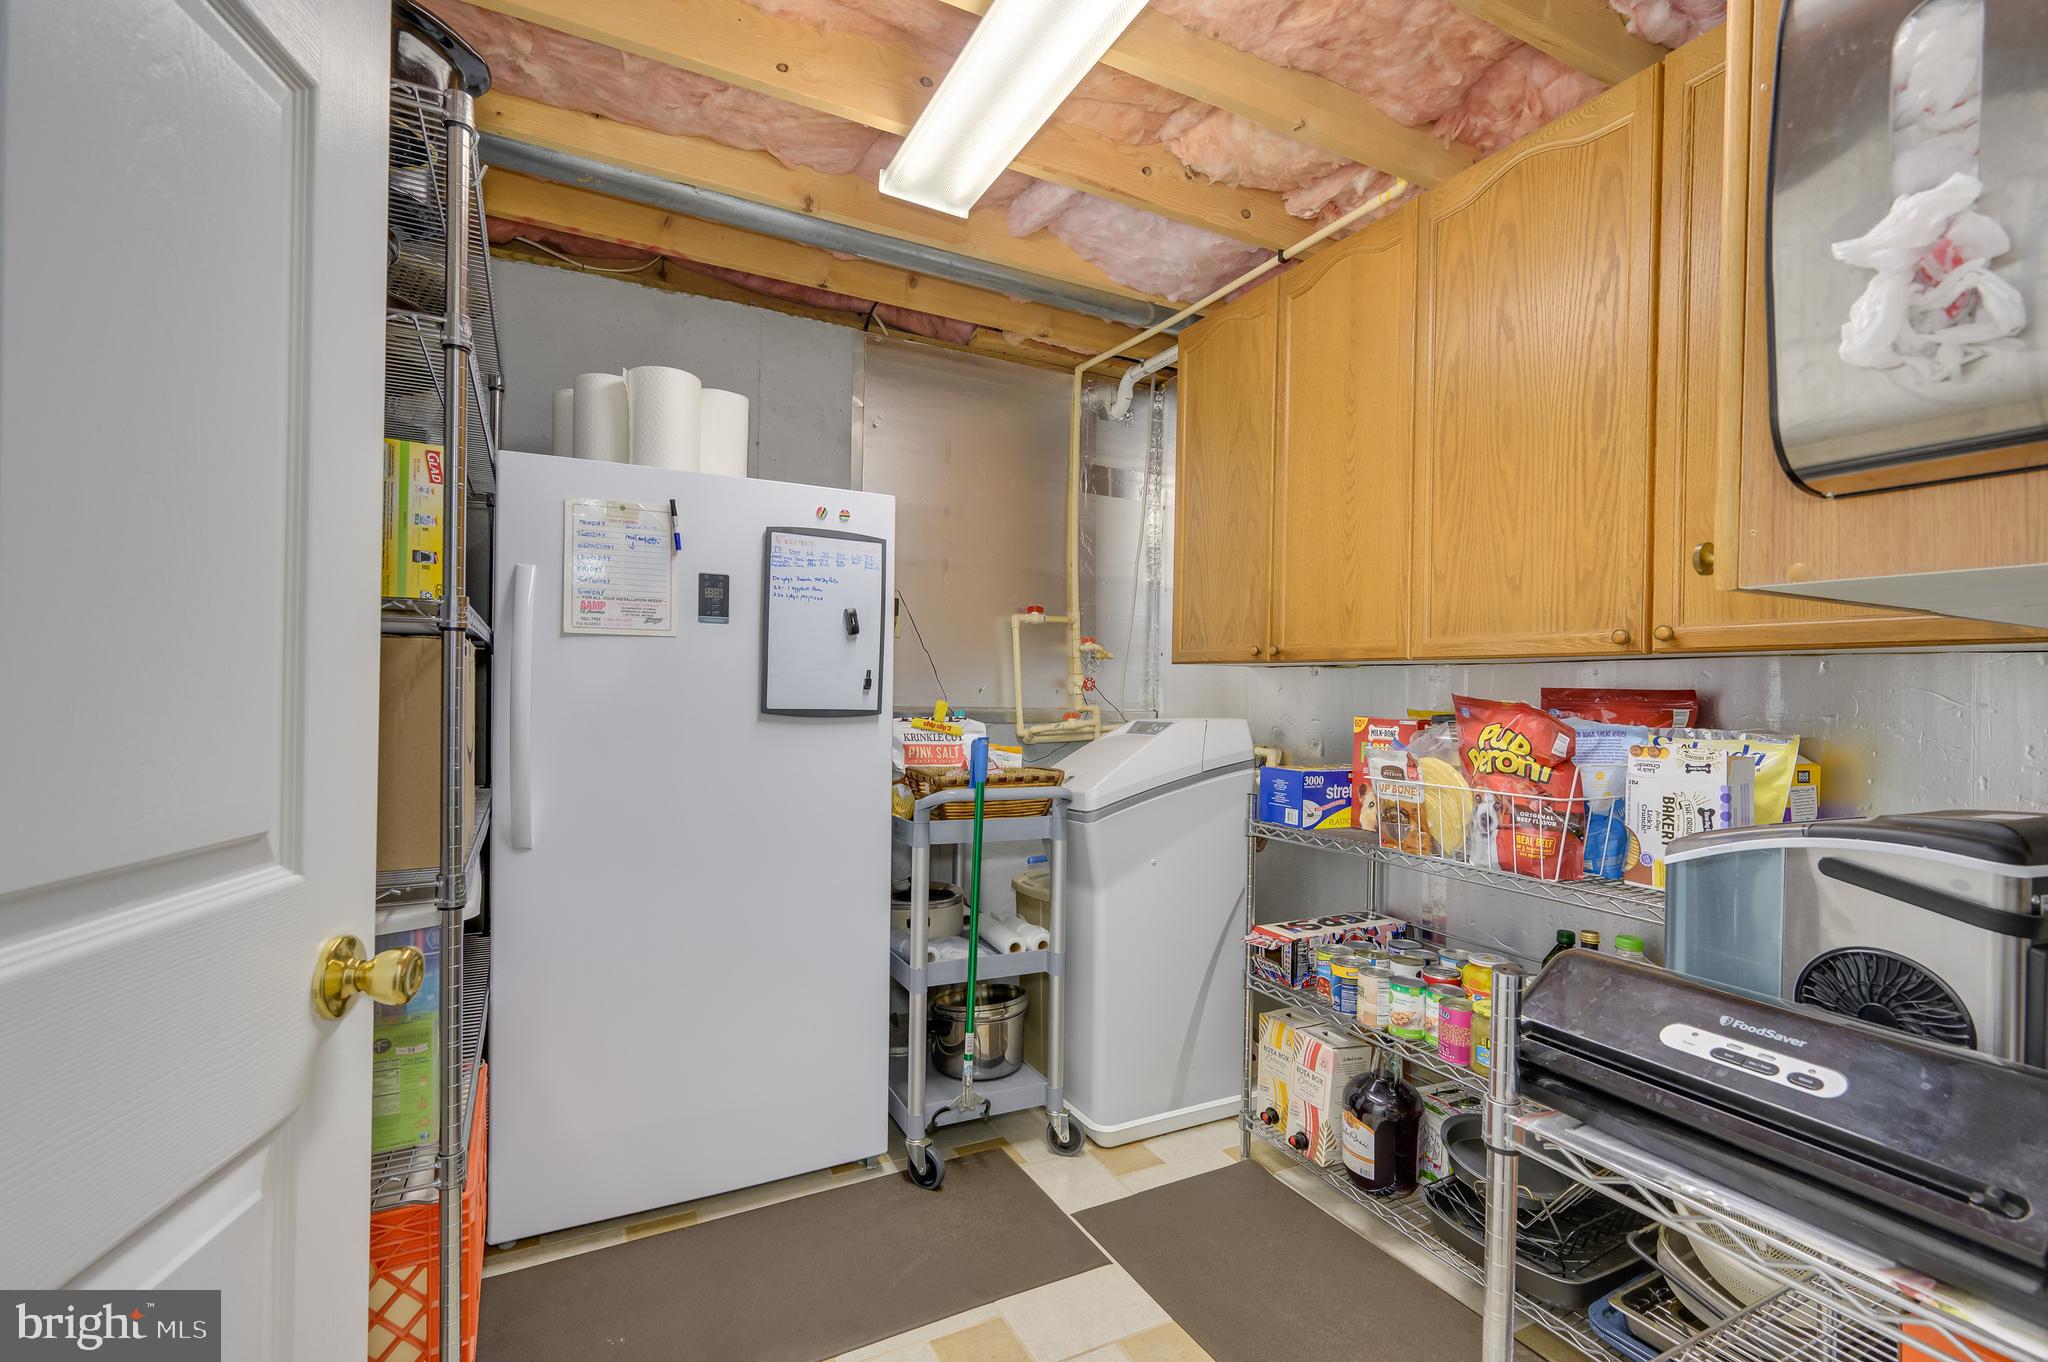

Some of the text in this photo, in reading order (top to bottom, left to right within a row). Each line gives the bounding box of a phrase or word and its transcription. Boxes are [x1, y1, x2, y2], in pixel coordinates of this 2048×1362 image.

[426, 451, 441, 484] GLAD
[580, 600, 606, 610] AAMP
[923, 721, 936, 729] chip
[903, 732, 944, 742] KRINKLE
[1370, 728, 1397, 737] MILK-BONE
[908, 746, 960, 759] PINK SALT
[1303, 775, 1325, 786] 3000
[1731, 1019, 1808, 1048] FoodSaver
[1278, 1052, 1290, 1063] BOX
[1311, 1075, 1324, 1086] BOX
